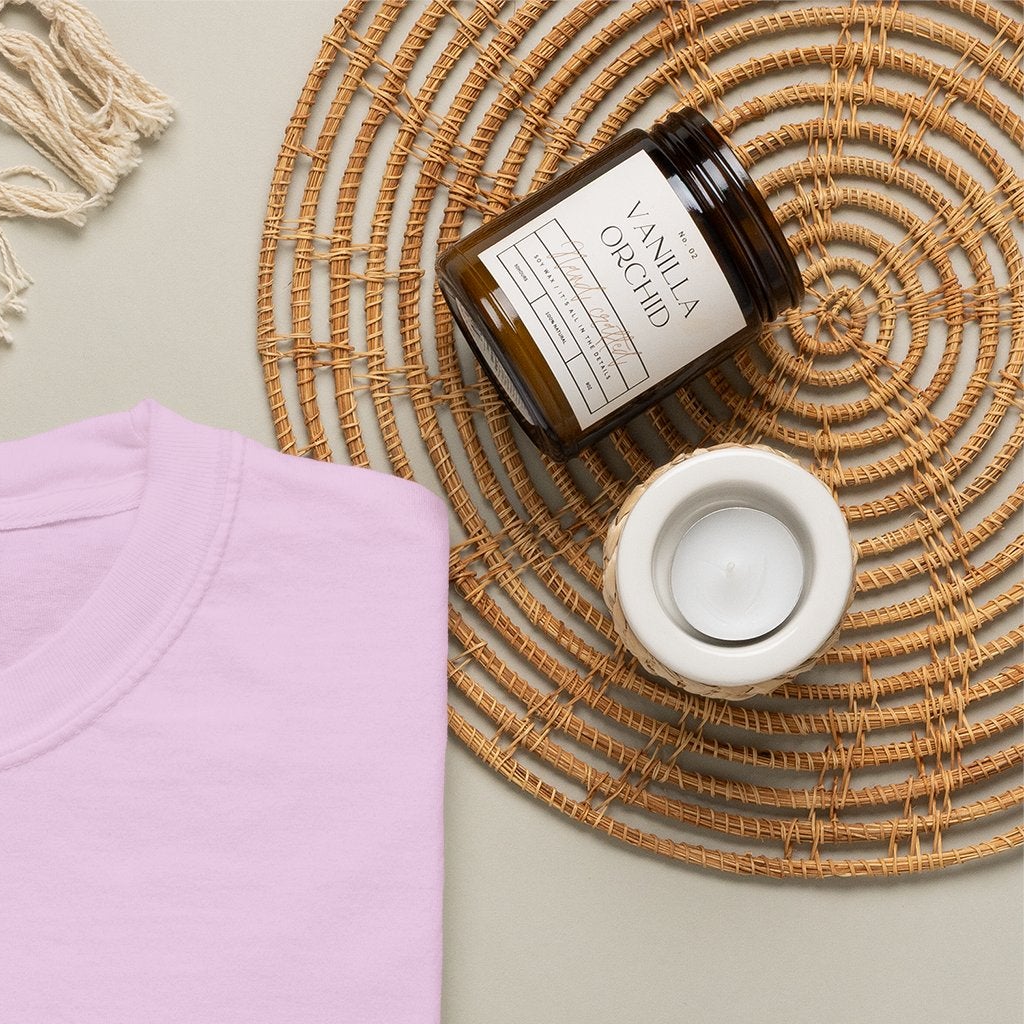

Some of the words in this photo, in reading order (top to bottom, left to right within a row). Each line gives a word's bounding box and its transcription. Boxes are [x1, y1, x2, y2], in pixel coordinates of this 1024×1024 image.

[600, 225, 670, 327] ORCHID
[627, 200, 700, 318] VANILLA
[688, 247, 698, 260] 02
[534, 254, 545, 267] SOY
[543, 269, 555, 283] WAX
[558, 290, 569, 306] IT'S
[569, 309, 579, 322] ALL
[578, 324, 586, 333] IN
[585, 335, 595, 349] THE
[593, 351, 611, 380] DETAILS
[553, 324, 567, 345] NATURAL
